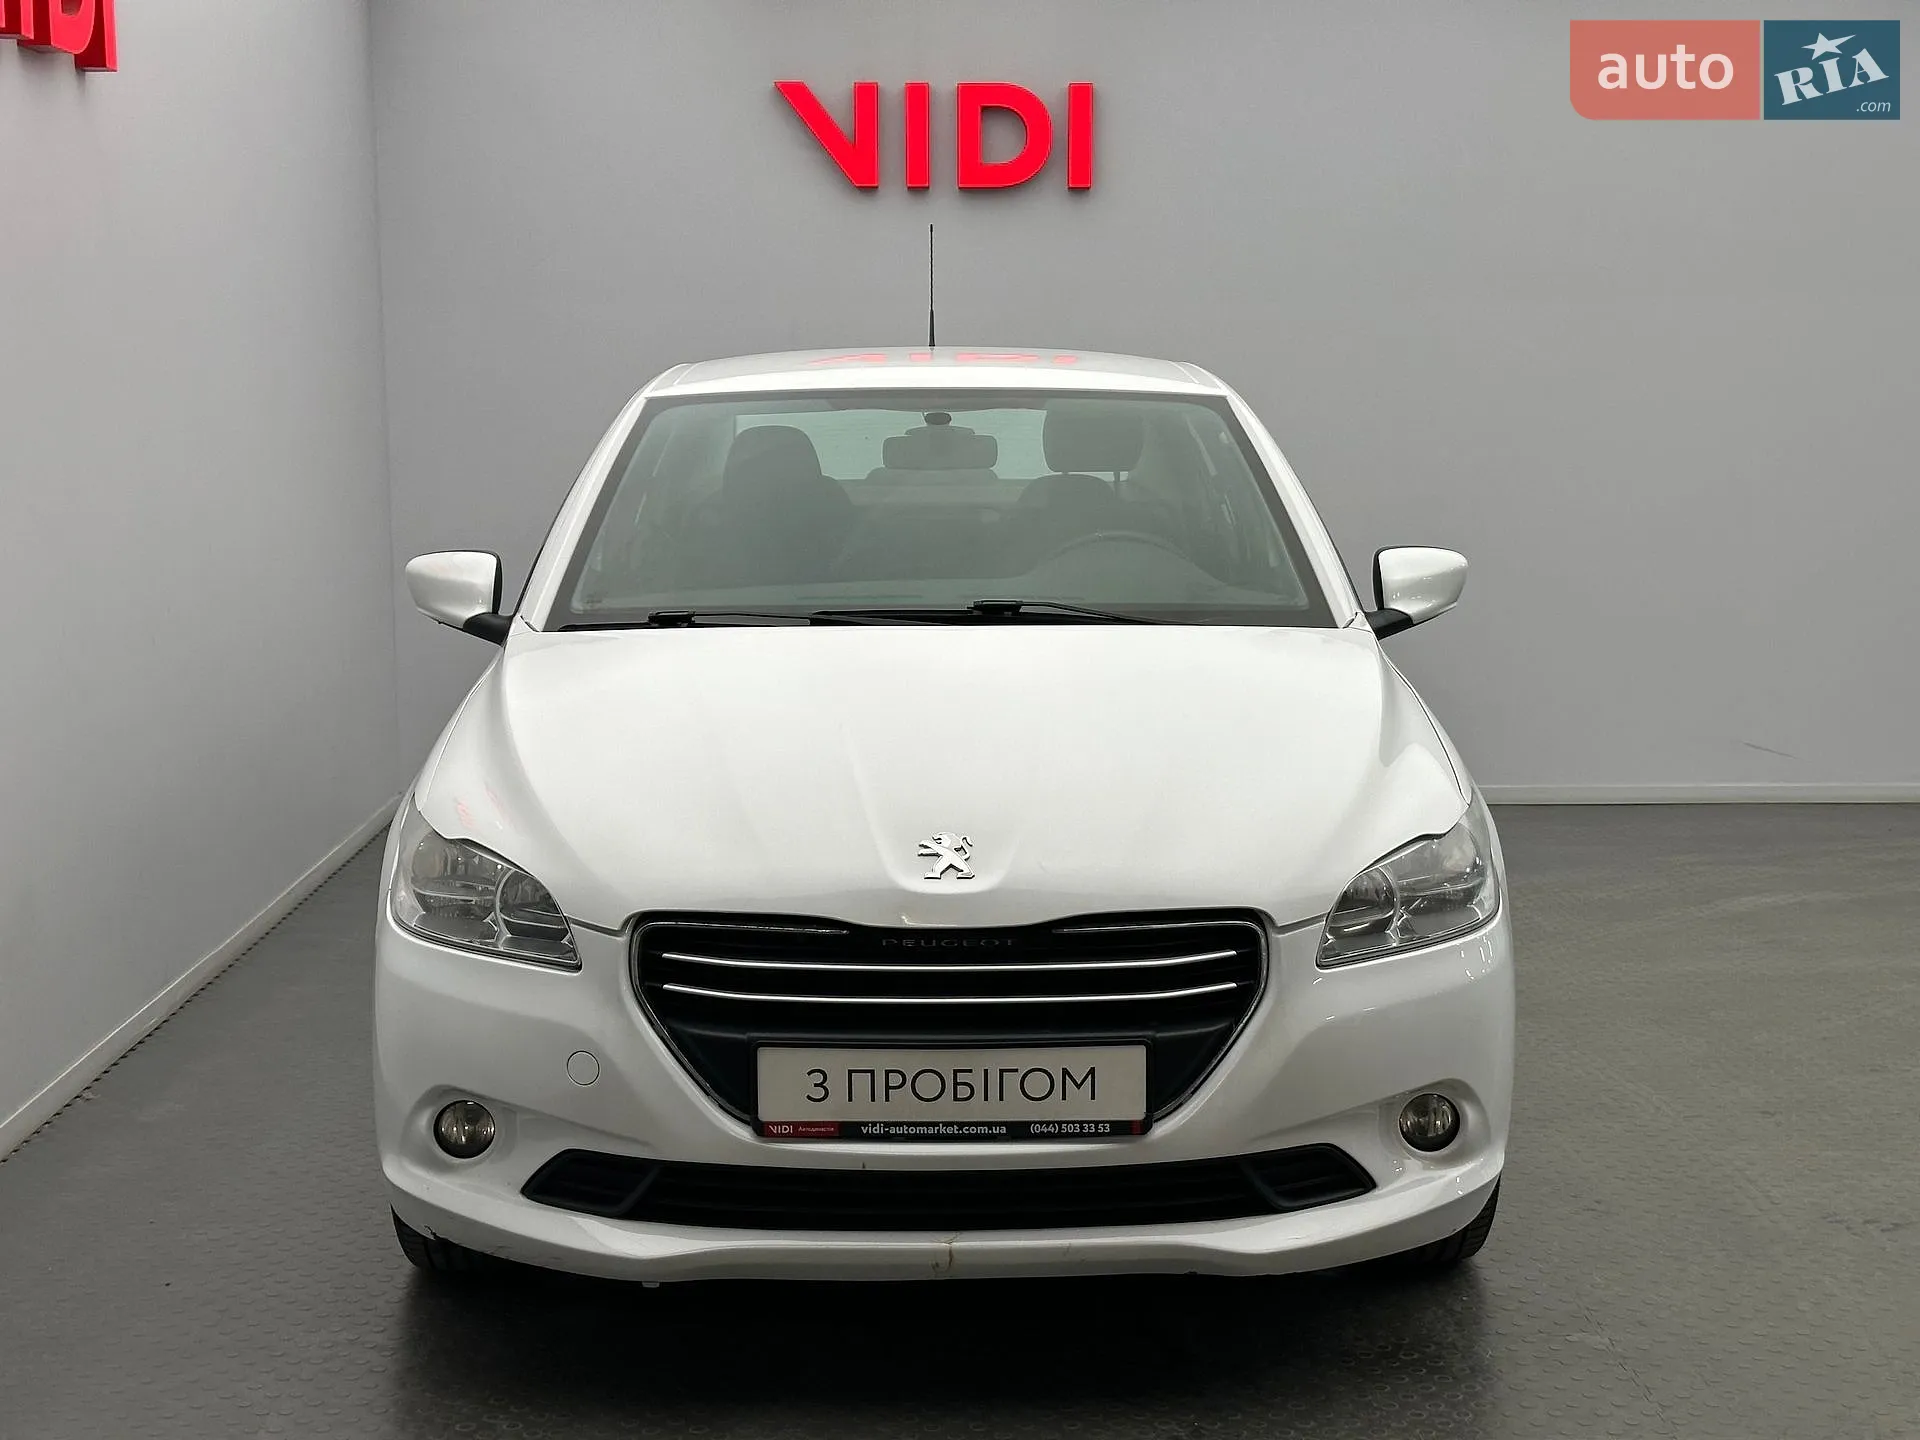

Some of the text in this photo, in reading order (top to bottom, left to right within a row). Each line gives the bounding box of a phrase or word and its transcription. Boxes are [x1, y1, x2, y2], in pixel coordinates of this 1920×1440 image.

[774, 81, 1094, 190] VIDI
[882, 938, 1016, 948] PEUGEOT
[847, 1066, 1097, 1103] ПРОБІГОМ
[768, 1125, 793, 1134] VIDI
[861, 1123, 1007, 1135] vidi-automarket.com.ua
[1030, 1123, 1111, 1134] (044) 503 33 53
